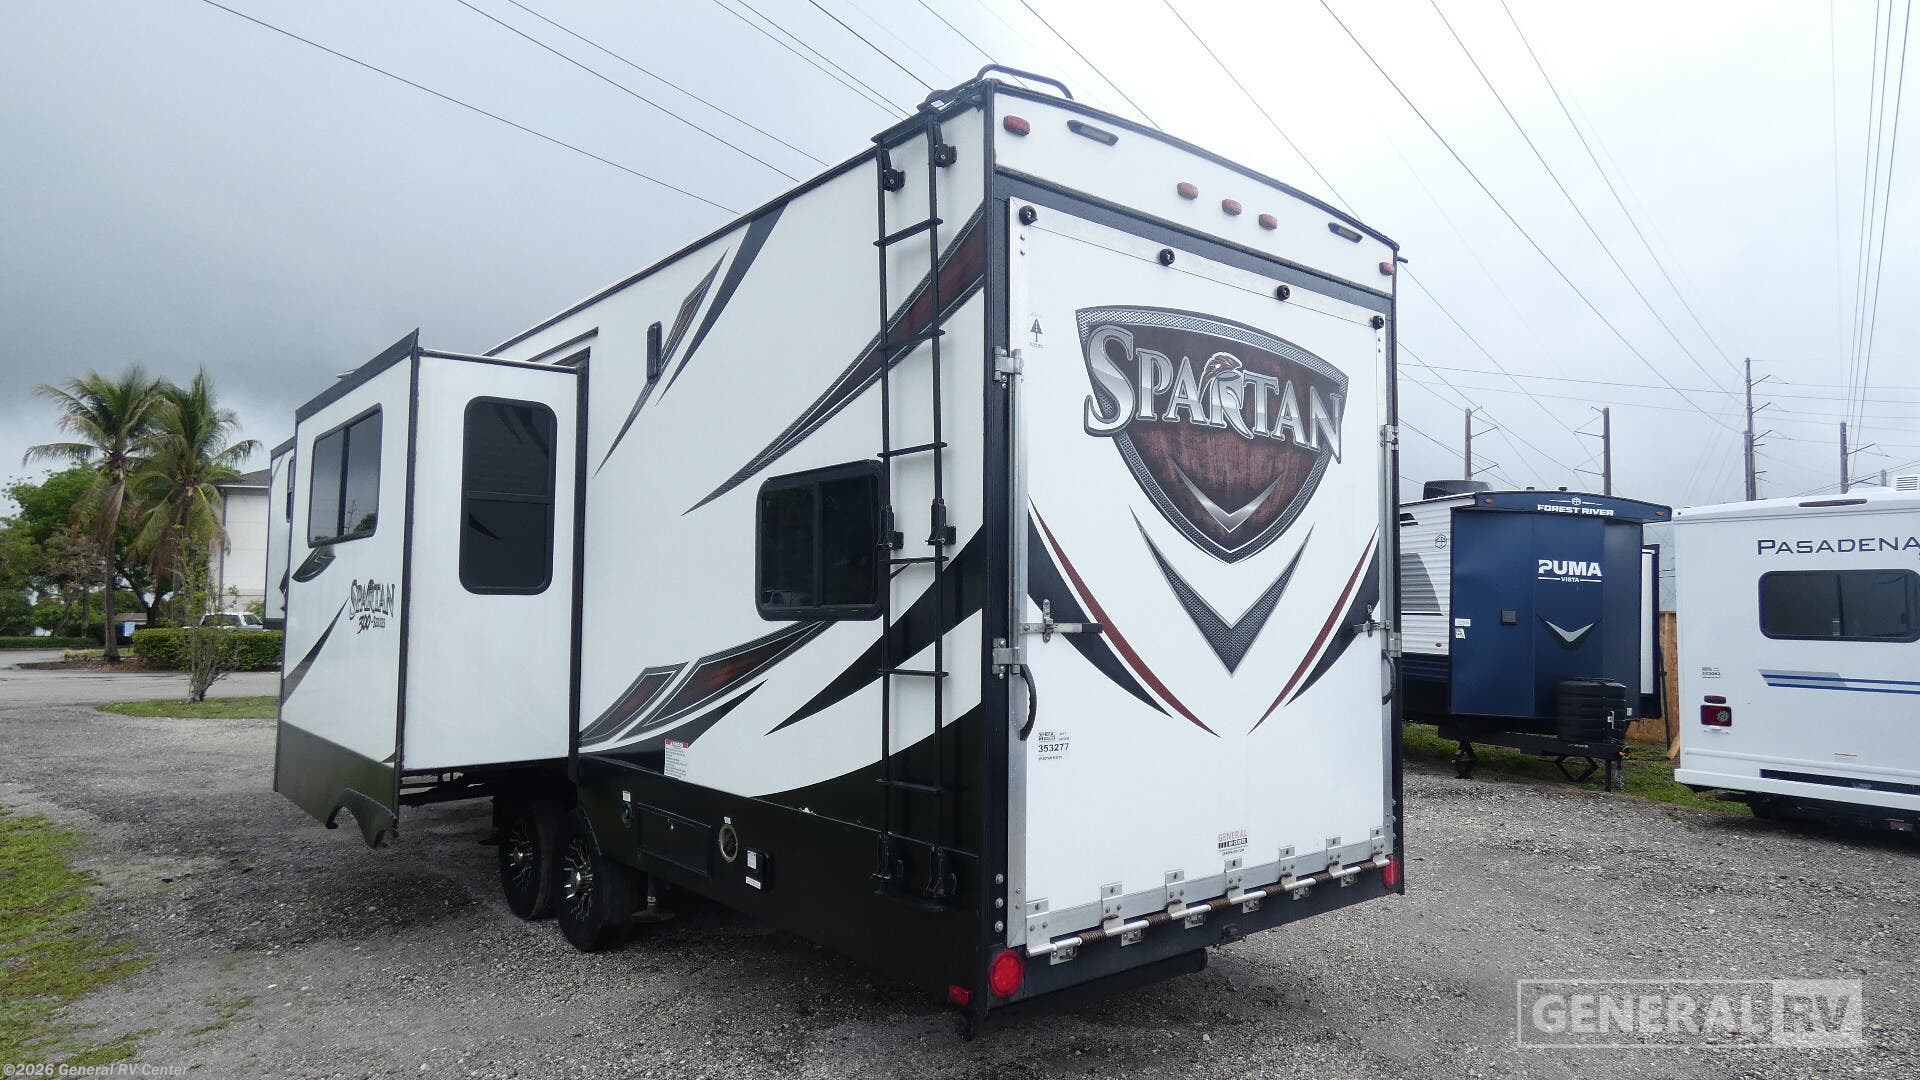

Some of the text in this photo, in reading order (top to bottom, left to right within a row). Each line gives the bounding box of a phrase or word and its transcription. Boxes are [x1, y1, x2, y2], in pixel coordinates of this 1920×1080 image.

[1084, 324, 1342, 464] SPARTAN
[1537, 504, 1614, 516] FOREST RIVER
[1757, 536, 1920, 555] PASADENA
[1538, 559, 1602, 577] PUMA
[349, 578, 396, 620] SPARTAN
[1038, 742, 1070, 753] 353277
[1218, 828, 1249, 842] GENERAL
